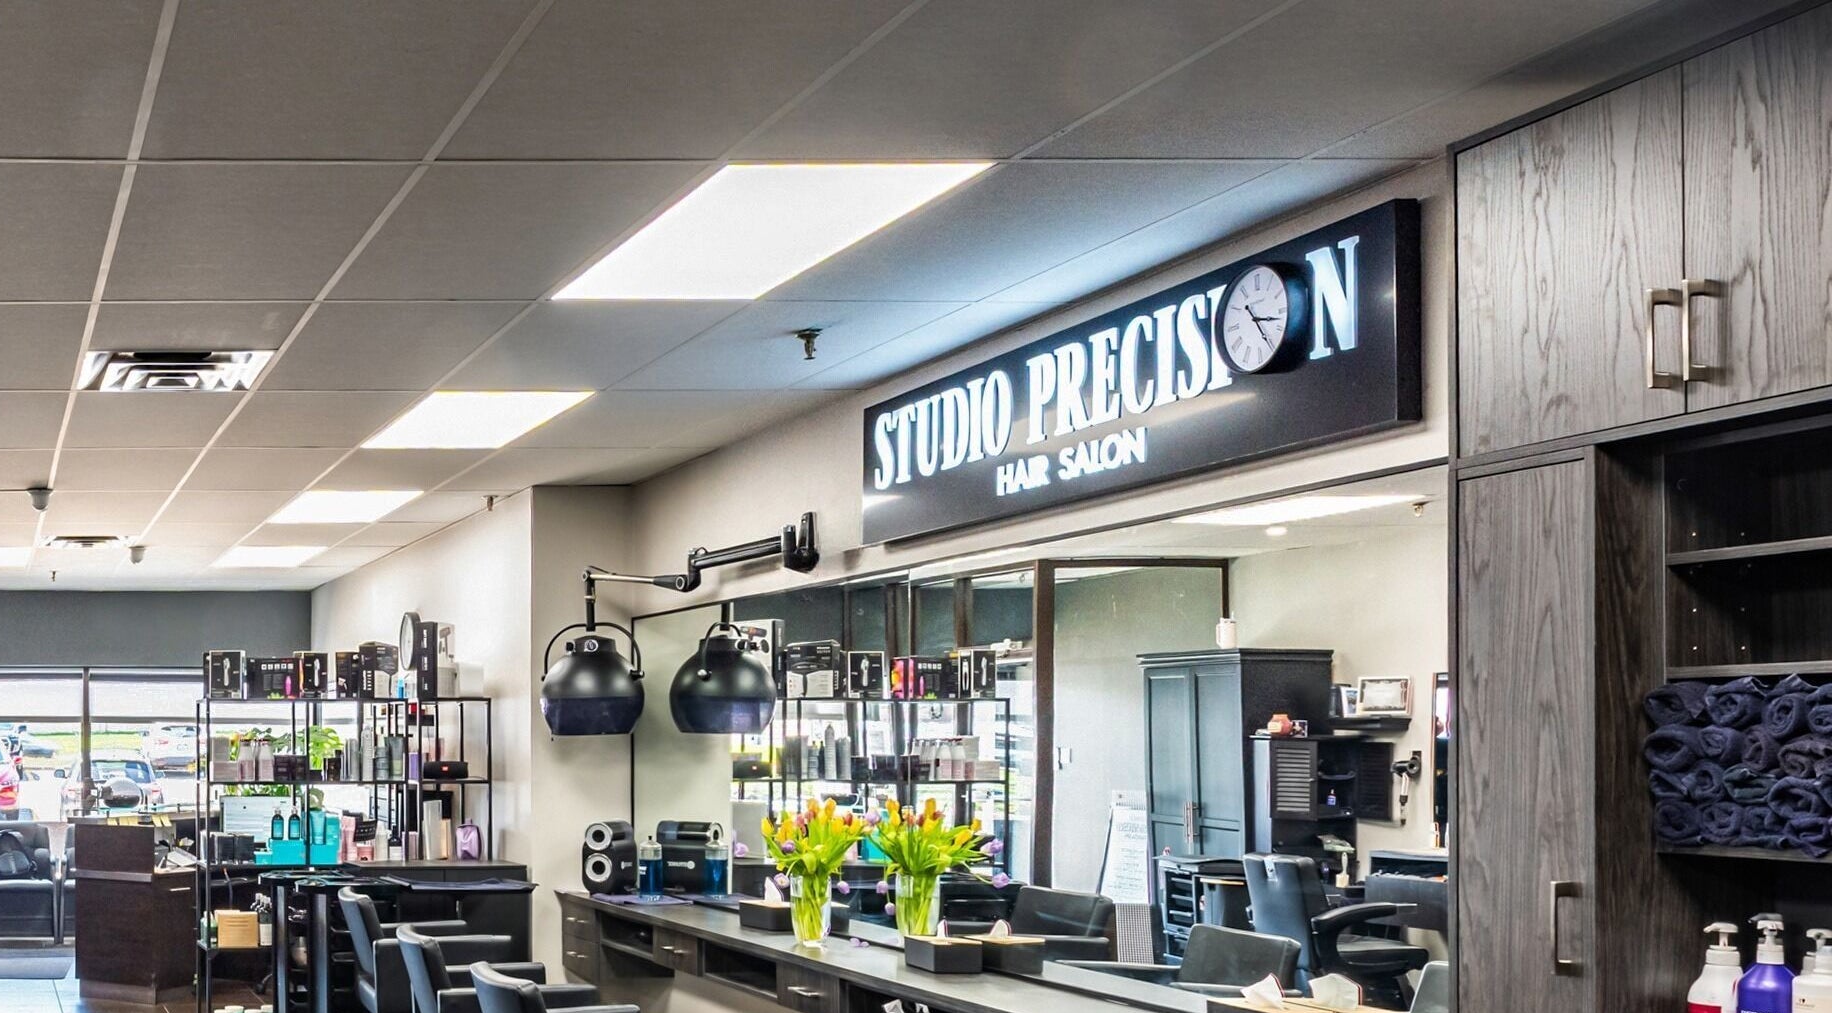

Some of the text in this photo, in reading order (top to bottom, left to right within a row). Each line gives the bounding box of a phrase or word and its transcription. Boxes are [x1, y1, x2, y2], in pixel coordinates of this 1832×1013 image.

[873, 235, 1361, 490] STUDIO PRECISIN
[995, 427, 1147, 497] HAIR SALON
